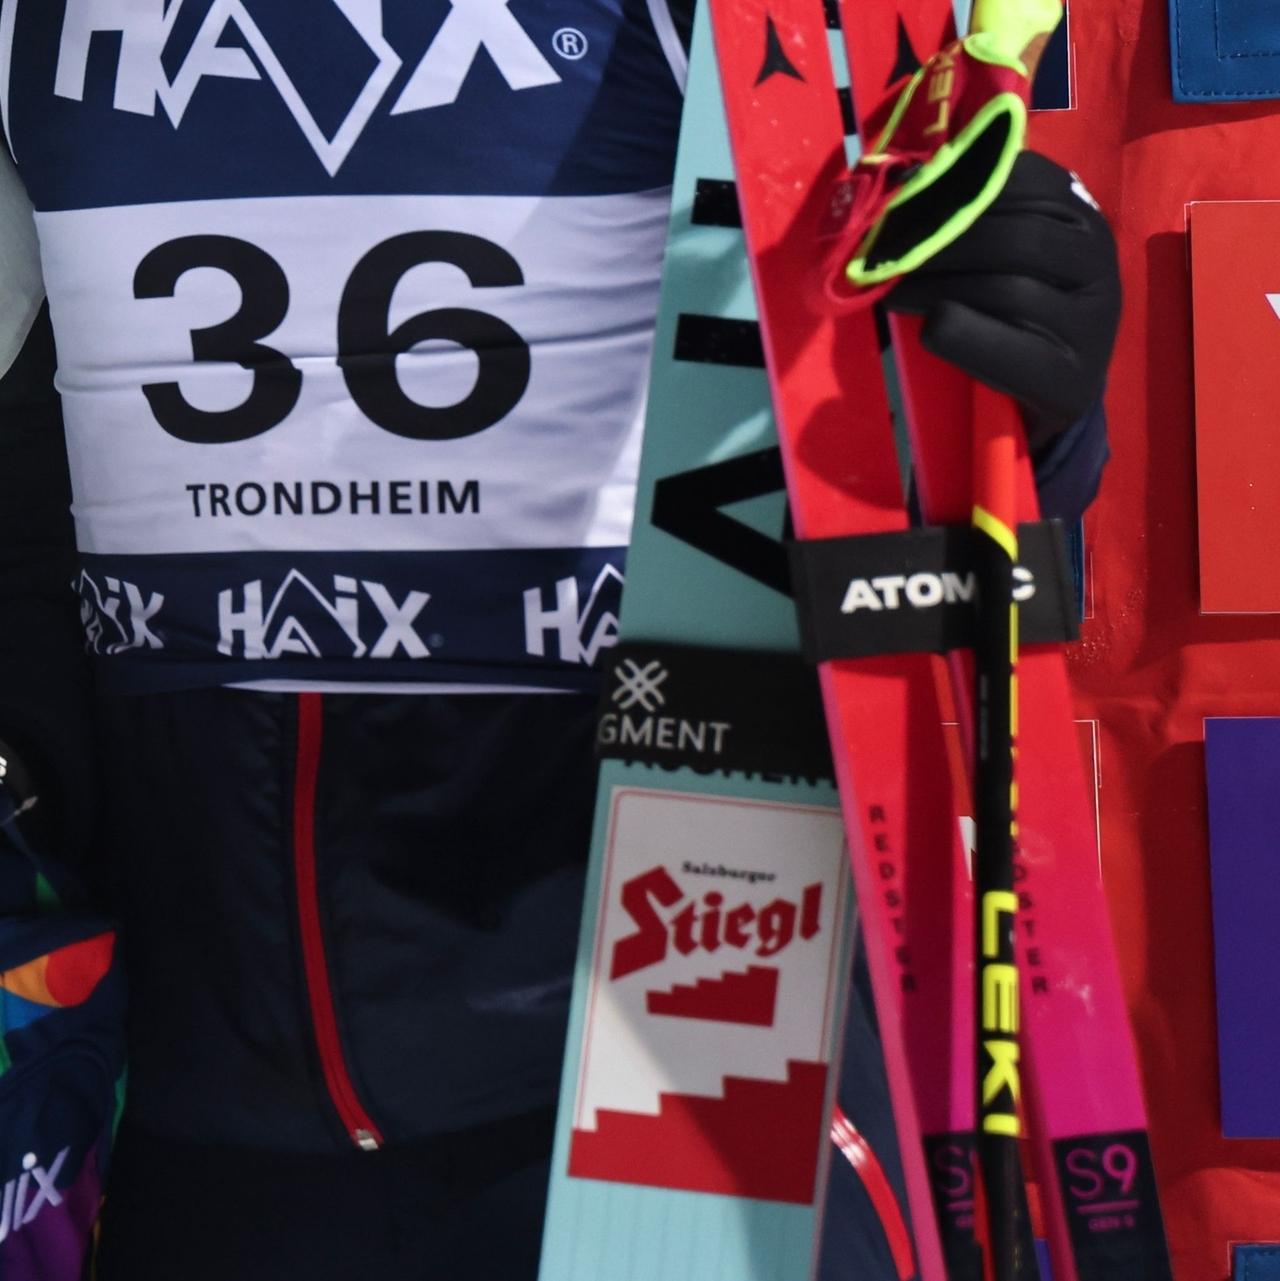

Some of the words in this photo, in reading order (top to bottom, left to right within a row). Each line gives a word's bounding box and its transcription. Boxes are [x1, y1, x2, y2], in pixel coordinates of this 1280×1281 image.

[132, 229, 531, 444] 36
[185, 479, 481, 517] TRONDHEIM
[841, 570, 1036, 613] ATOMC
[609, 865, 823, 982] Stiegl
[982, 890, 1020, 1137] LEKI
[1065, 1143, 1138, 1198] S9
